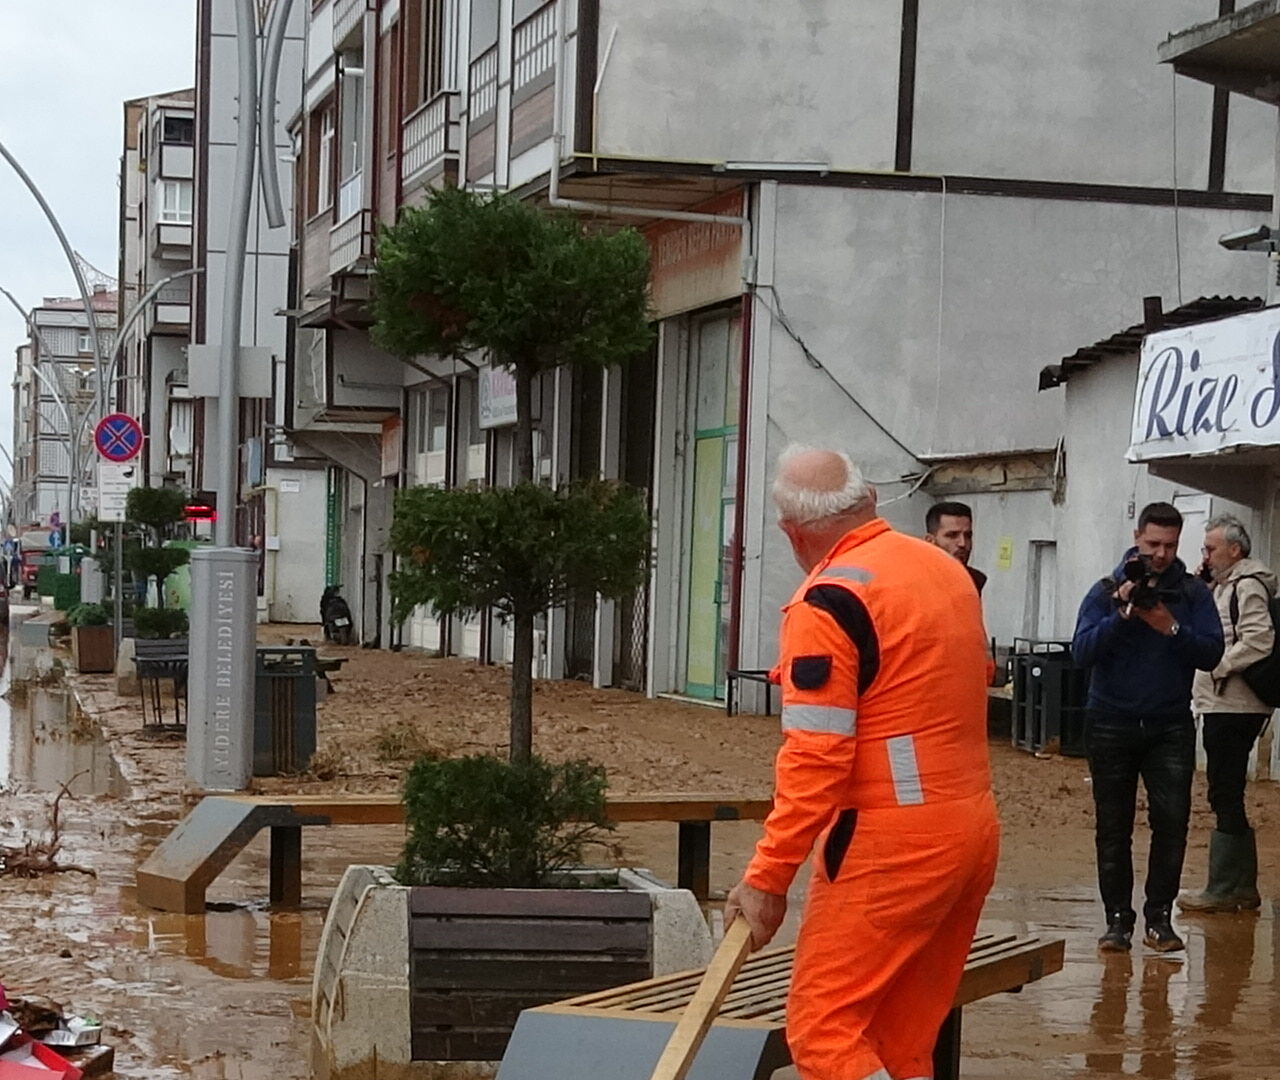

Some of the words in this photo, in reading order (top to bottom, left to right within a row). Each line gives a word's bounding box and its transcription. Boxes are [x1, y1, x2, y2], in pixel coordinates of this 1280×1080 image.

[1138, 346, 1238, 440] Rize
[215, 571, 234, 687] BELEDİYESİ
[213, 696, 230, 776] YİDERE
